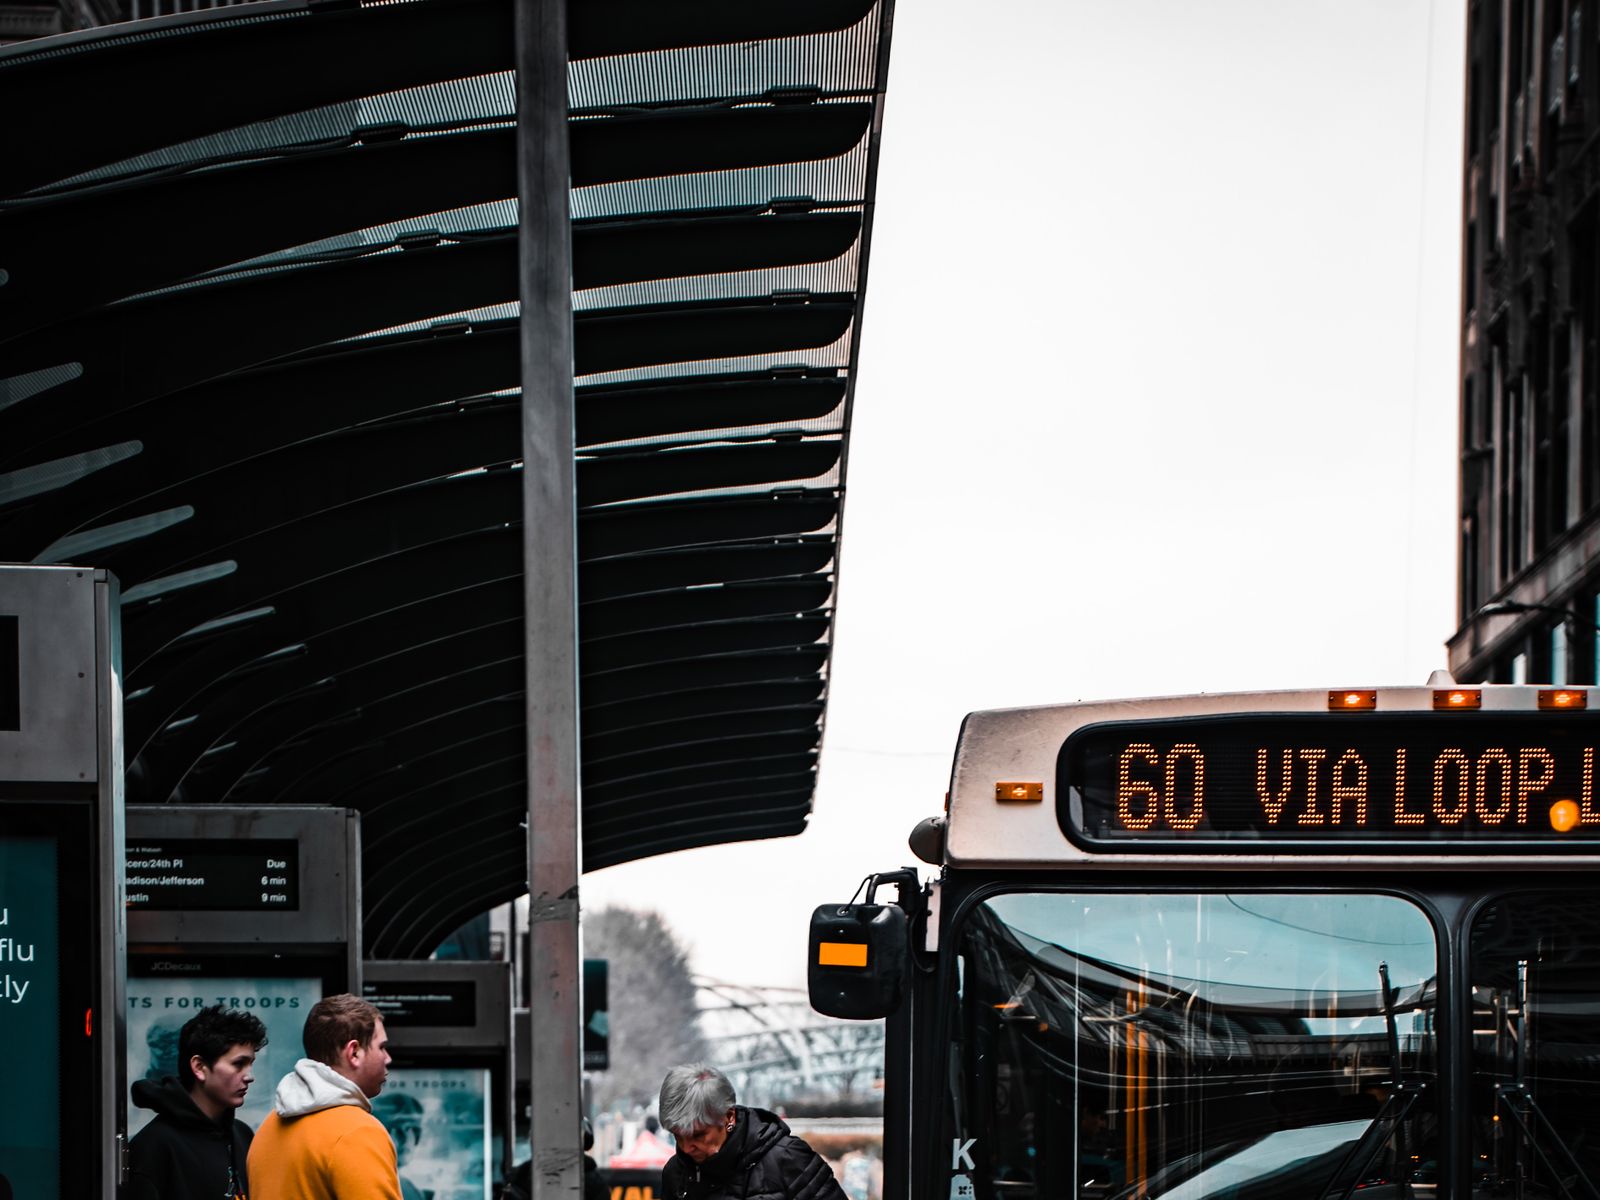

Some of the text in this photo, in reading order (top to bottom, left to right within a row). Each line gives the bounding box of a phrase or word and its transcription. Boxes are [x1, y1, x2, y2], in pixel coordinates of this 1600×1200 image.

[1118, 743, 1205, 830] 60
[1256, 747, 1368, 825] VIA
[1394, 747, 1556, 825] LOOP
[125, 859, 171, 869] cero/24th
[266, 859, 287, 869] Due
[125, 876, 287, 886] adison/Jefferson 6 min
[125, 893, 287, 903] ustin 9 min
[151, 961, 201, 971] JCDecaux
[0, 973, 30, 1004] ly
[164, 996, 205, 1009] FOR
[215, 996, 300, 1009] TROOPS
[413, 1080, 467, 1089] TROOPS
[952, 1138, 977, 1170] K
